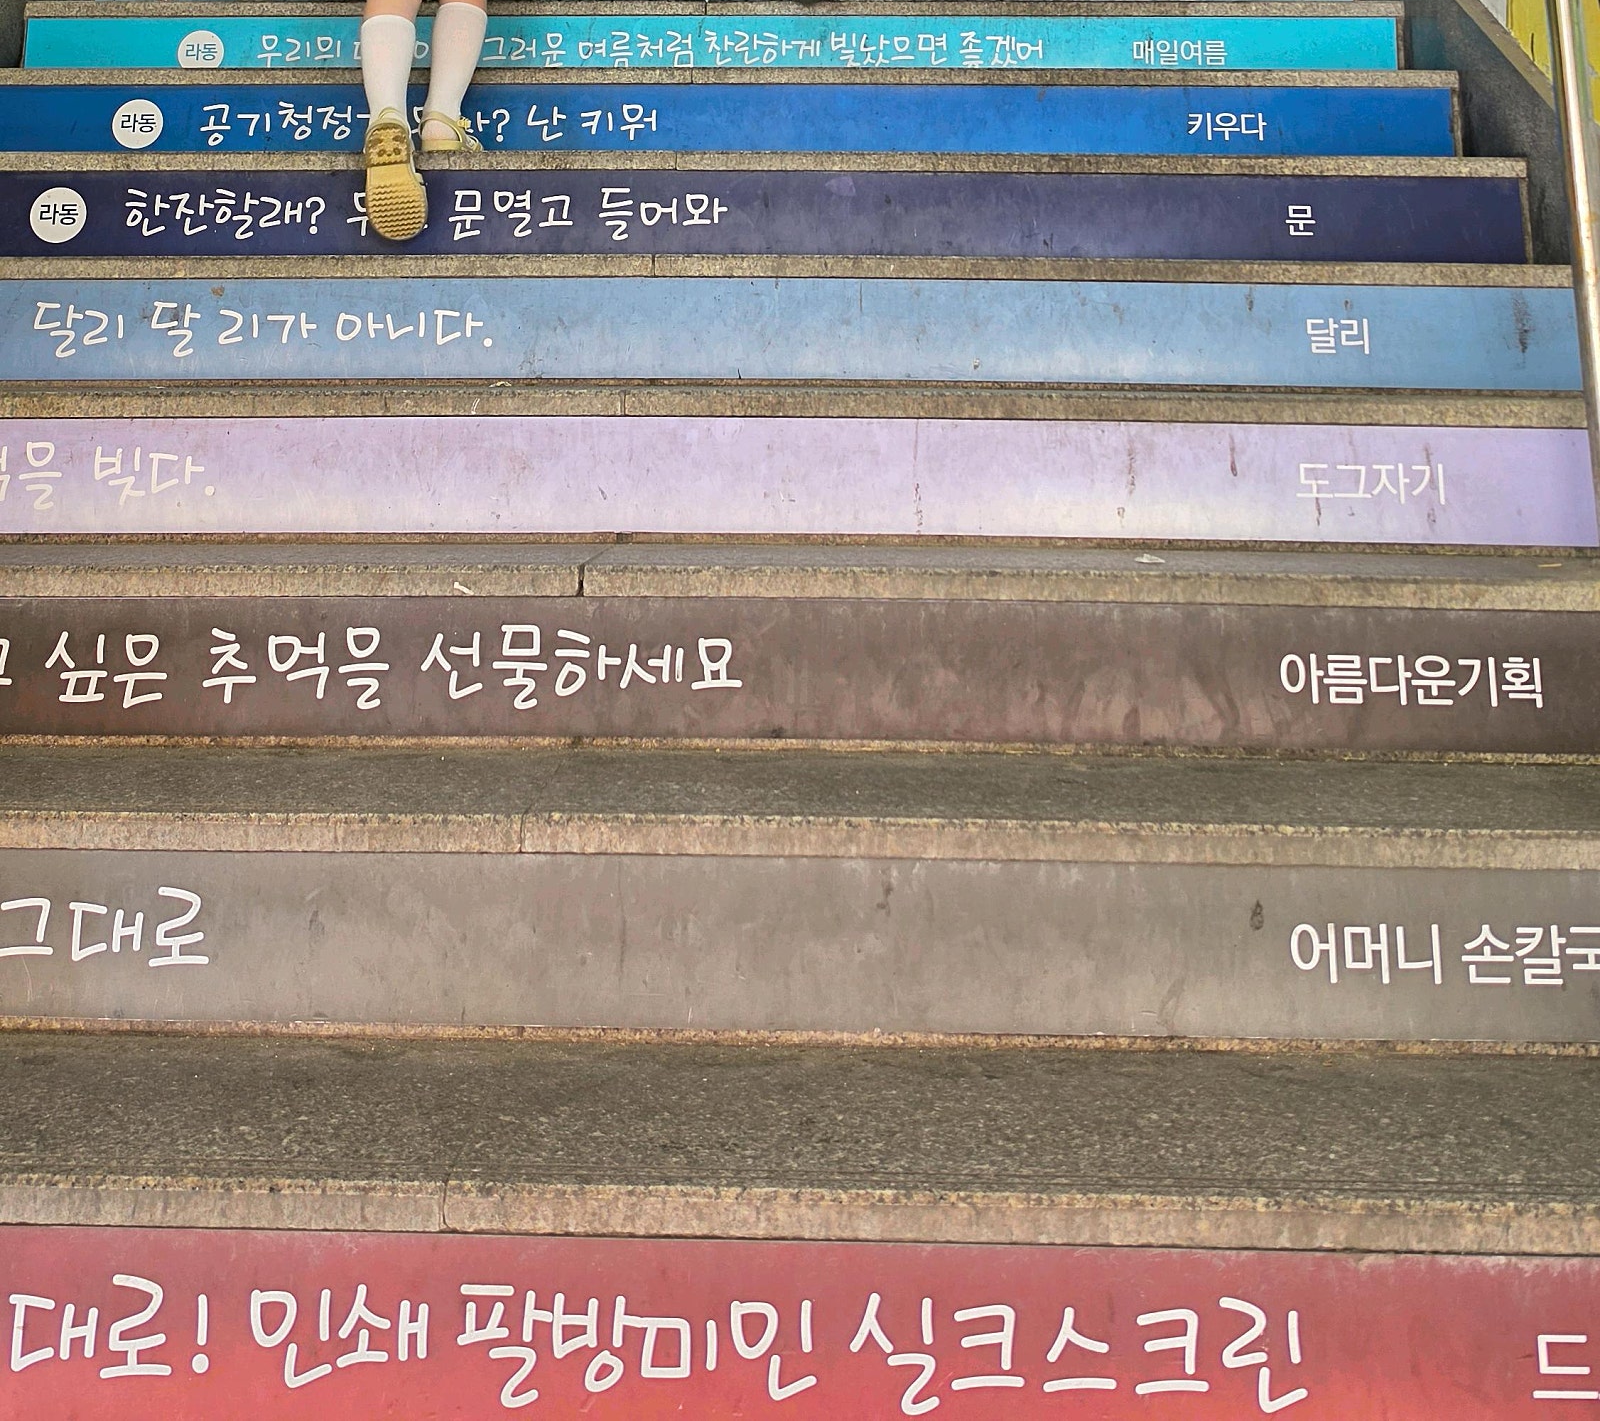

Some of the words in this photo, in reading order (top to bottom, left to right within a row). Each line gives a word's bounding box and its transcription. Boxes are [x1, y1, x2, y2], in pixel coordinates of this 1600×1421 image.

[185, 42, 218, 62] 라동
[256, 34, 341, 67] 우리의
[577, 30, 694, 67] 여름처럼
[703, 30, 821, 66] 찬란하게
[1132, 38, 1228, 67] 매일여름
[120, 112, 157, 134] 라동
[527, 104, 567, 141] 난
[1187, 112, 1268, 141] 키우다
[38, 203, 79, 226] 라동
[124, 187, 327, 240] 한잔할래?
[598, 186, 729, 241] 들어와
[1285, 204, 1316, 236] 문
[33, 300, 125, 358] 달리
[335, 309, 494, 348] 아니다.
[1306, 317, 1371, 355] 달리
[0, 441, 63, 510] 을
[1296, 462, 1447, 506] 도그자기
[44, 630, 169, 710] 싶은
[201, 626, 391, 711] 추억을
[419, 624, 744, 711] 선물하세요
[1279, 652, 1544, 709] 아름다운기획
[0, 886, 210, 968] 그대로
[1289, 921, 1443, 985] 어머니
[8, 1274, 210, 1380] 대로!
[249, 1283, 430, 1390] 인쇄
[456, 1283, 819, 1410] 팔방미인
[848, 1292, 1309, 1416] 실크스크린
